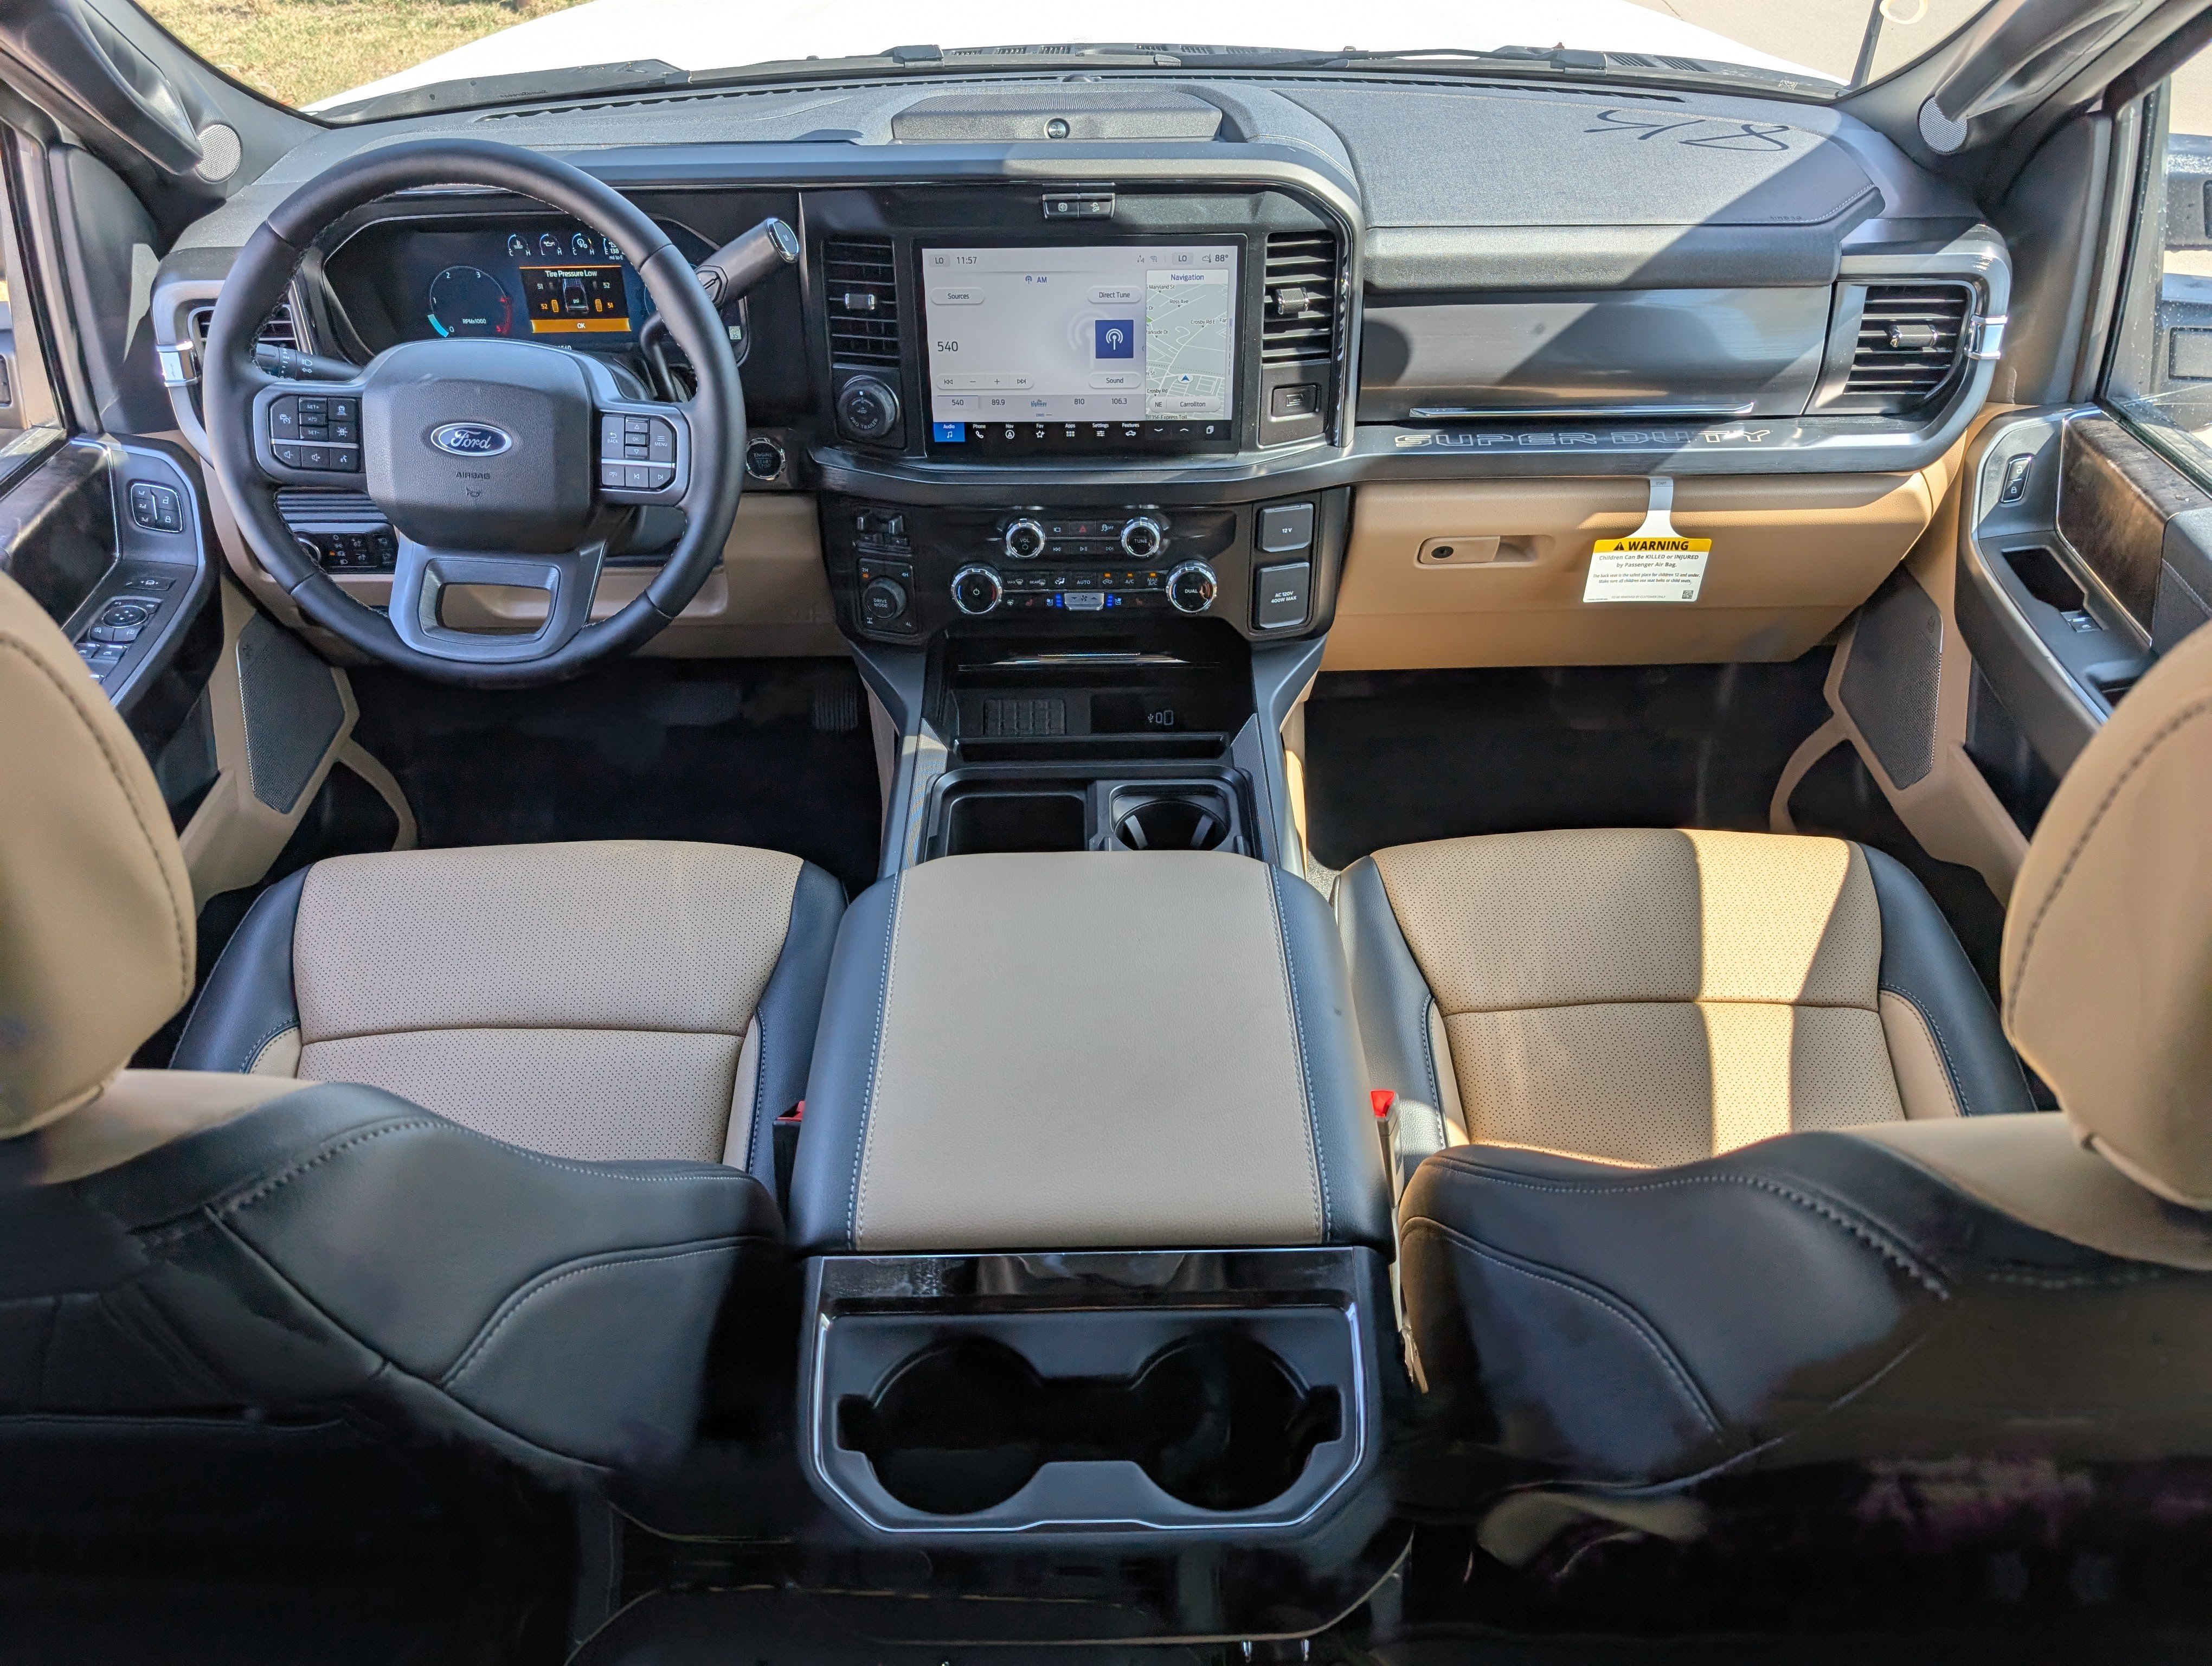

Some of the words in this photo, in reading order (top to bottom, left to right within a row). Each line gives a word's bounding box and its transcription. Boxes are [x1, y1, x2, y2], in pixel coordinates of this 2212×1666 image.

[1171, 274, 1204, 282] Navigation
[937, 341, 959, 352] 540
[861, 418, 878, 429] TRAILER
[451, 429, 492, 449] Ford
[1394, 432, 1597, 447] SUPER
[1610, 430, 1771, 445] DUTY
[455, 471, 491, 479] AIRBAG
[1628, 541, 1689, 551] WARNING
